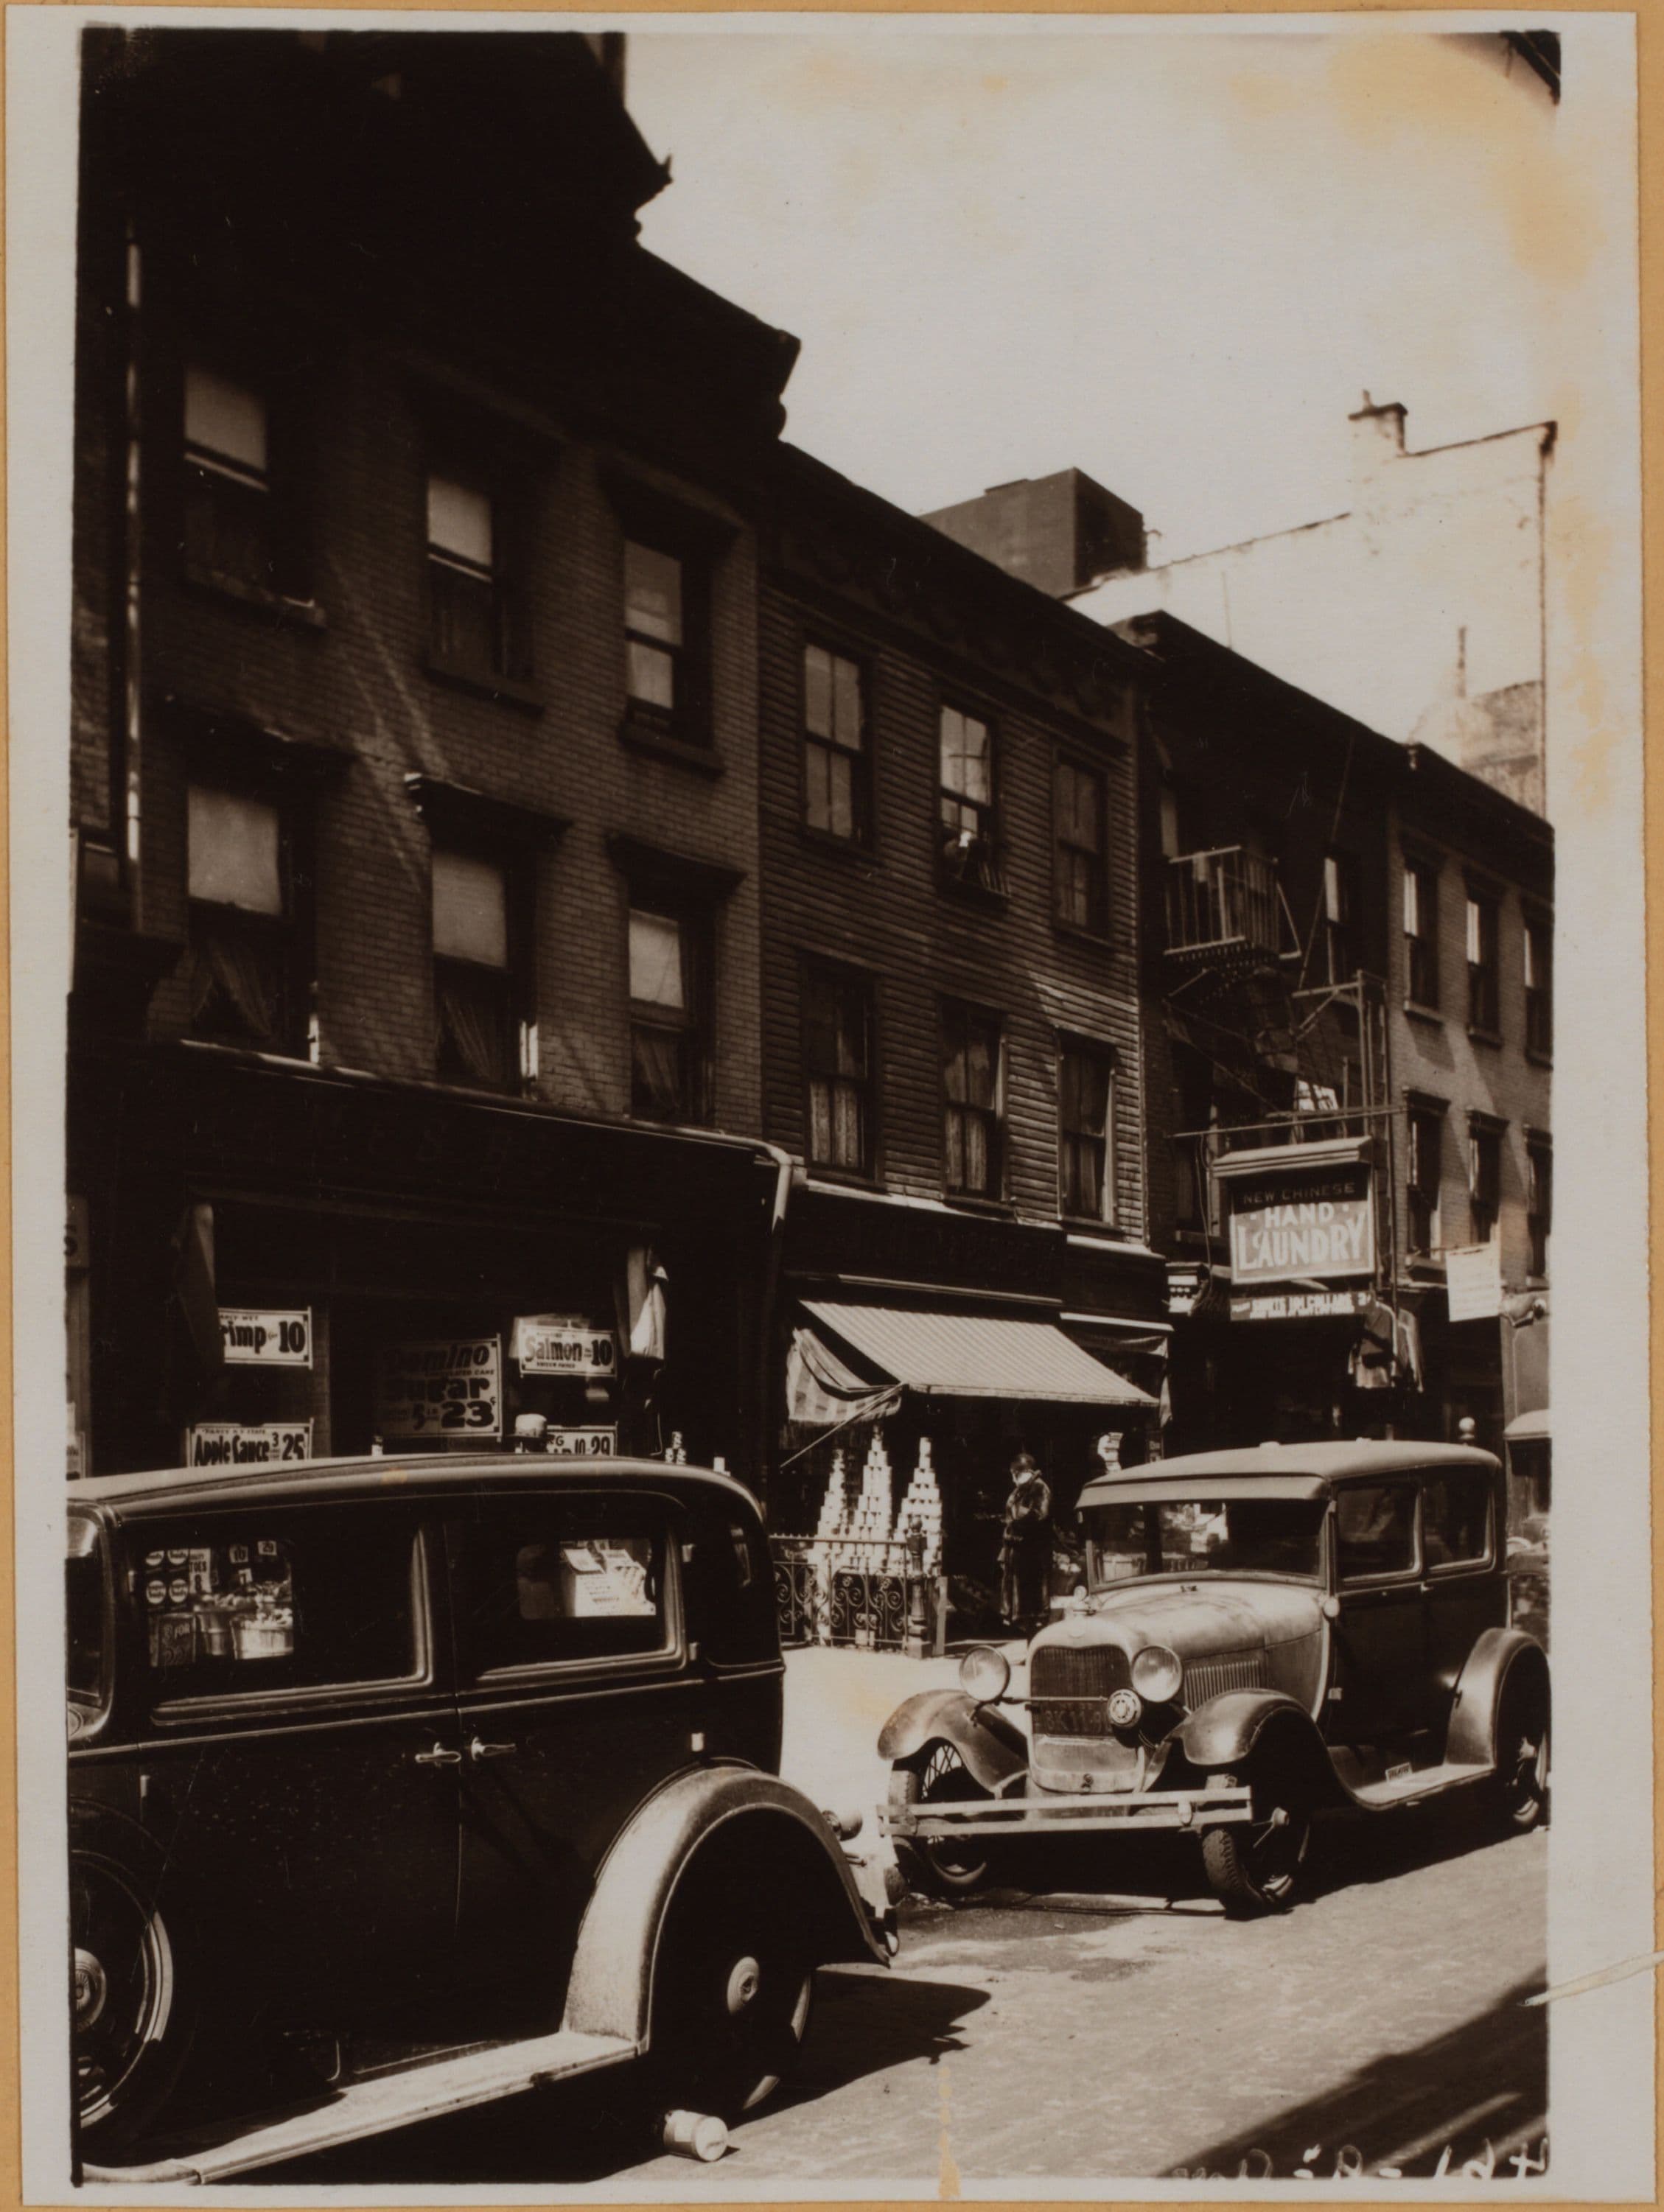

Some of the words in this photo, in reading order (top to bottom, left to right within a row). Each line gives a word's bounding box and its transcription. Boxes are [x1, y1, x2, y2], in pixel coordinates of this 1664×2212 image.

[1243, 1191, 1275, 1203] NEW
[1282, 1183, 1354, 1200] CHINESE
[1265, 1202, 1335, 1228] HAND
[1237, 1211, 1366, 1271] LAUNDRY
[220, 1320, 267, 1354] rimp
[279, 1321, 306, 1354] 10
[524, 1335, 583, 1363] Salmon
[591, 1339, 613, 1367] 10
[384, 1344, 490, 1371] mino
[386, 1377, 490, 1402] ugar
[194, 1434, 231, 1466] Apple
[272, 1432, 279, 1448] 3
[282, 1433, 306, 1461] 25
